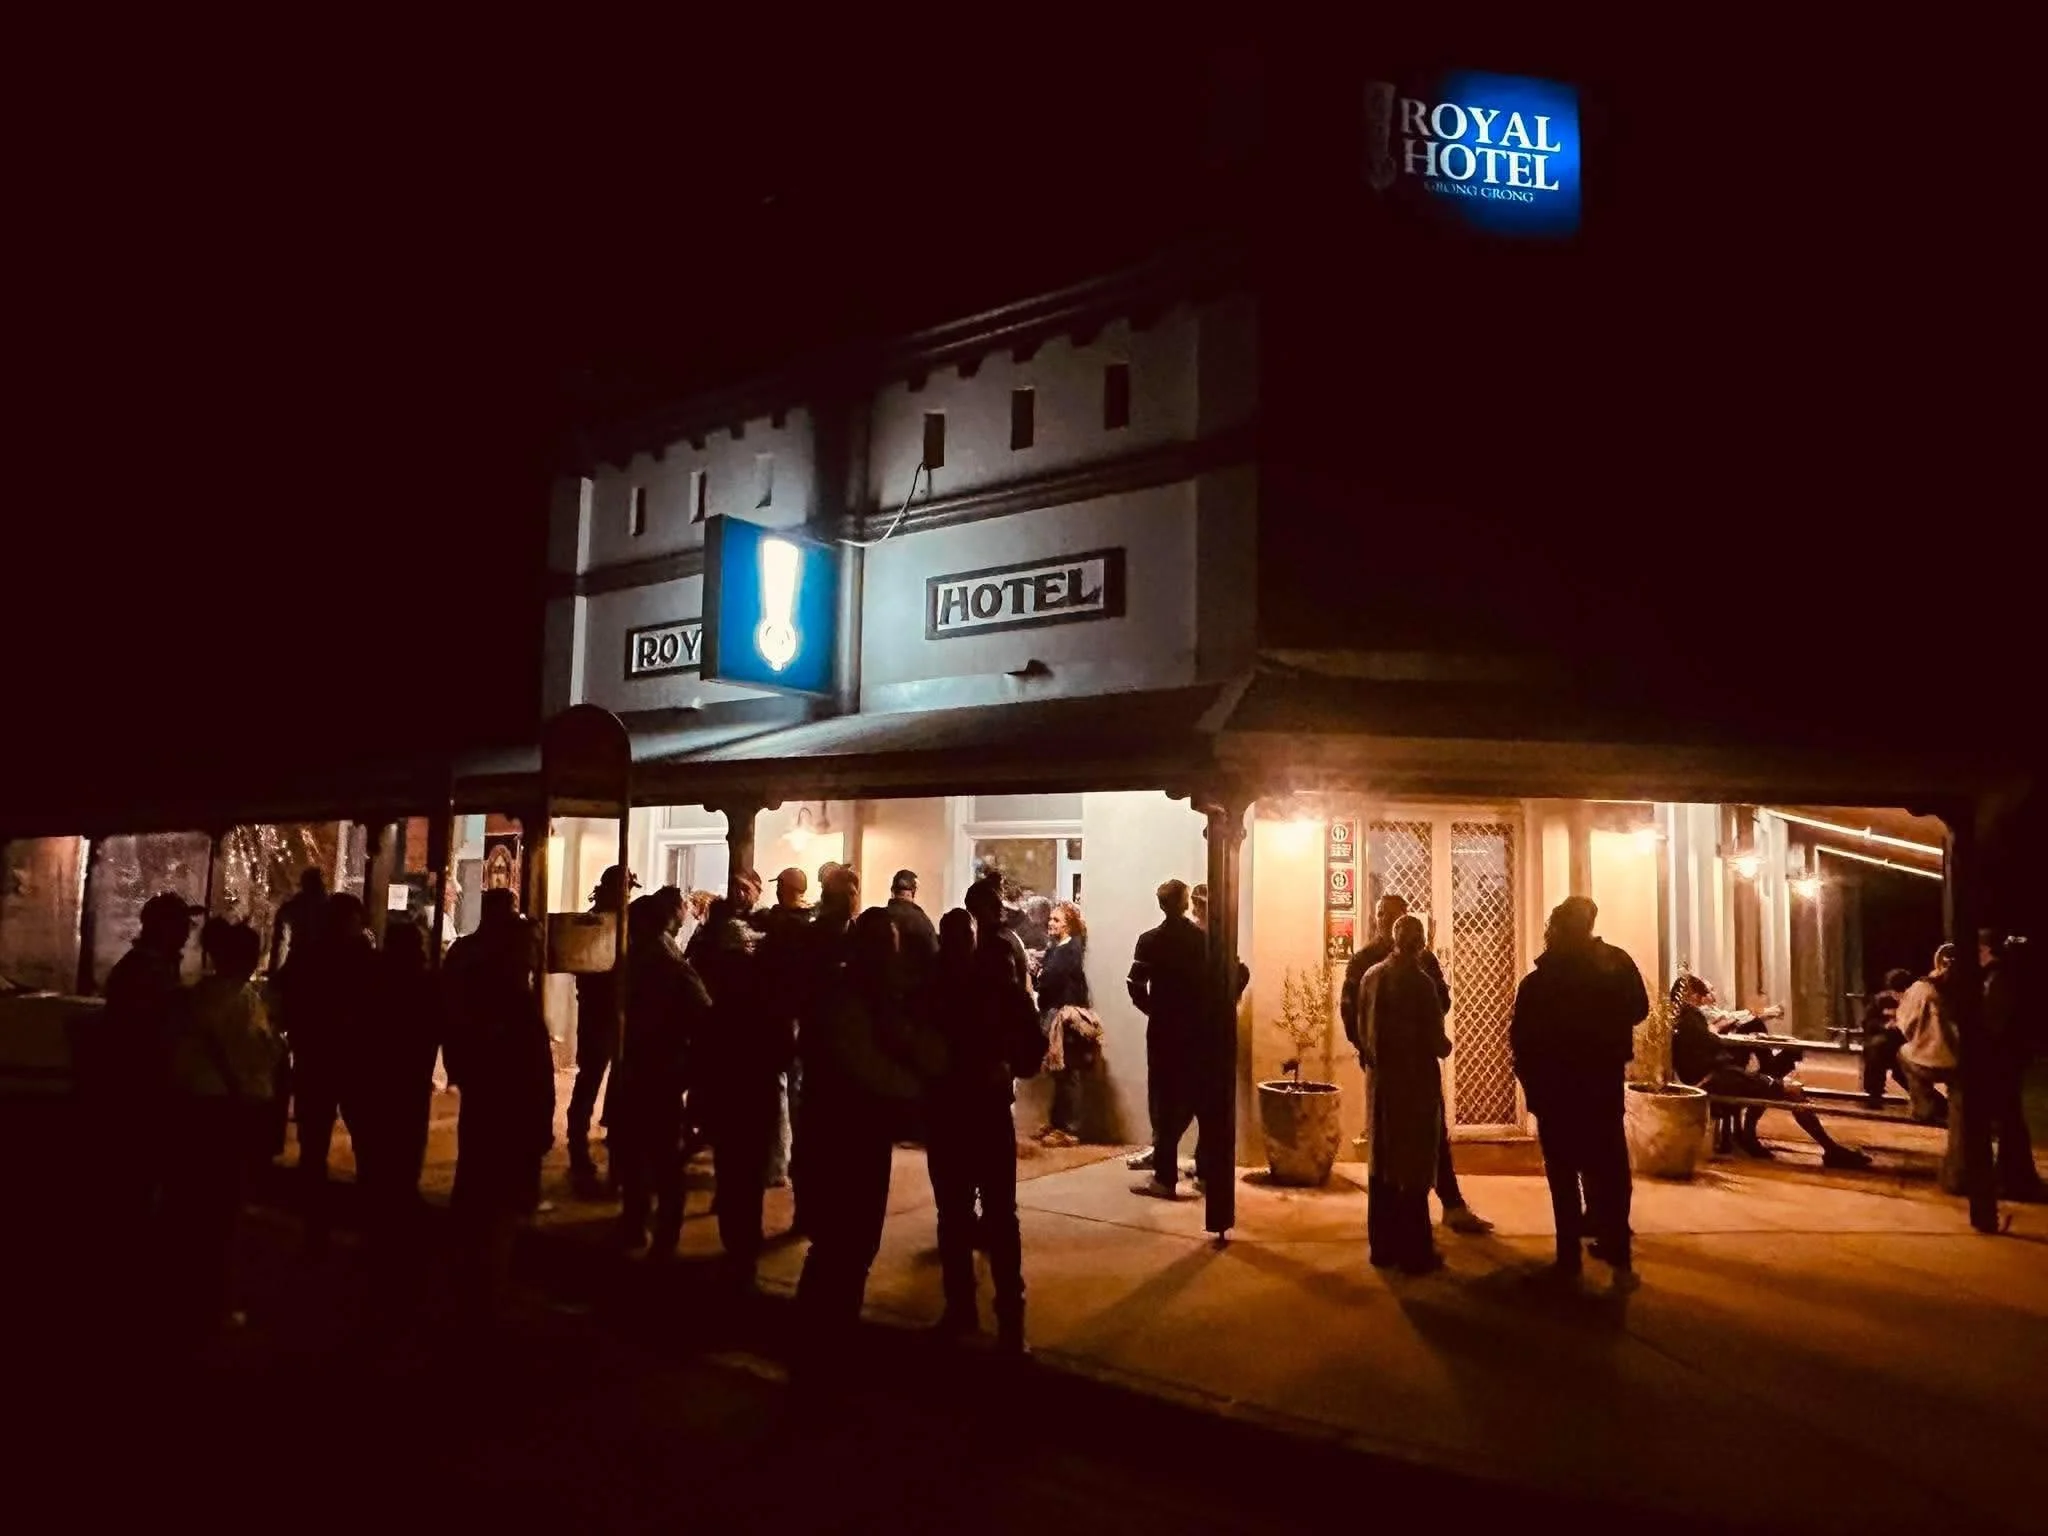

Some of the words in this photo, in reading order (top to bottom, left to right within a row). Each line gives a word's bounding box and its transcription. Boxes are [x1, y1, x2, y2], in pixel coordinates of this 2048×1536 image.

[1400, 97, 1561, 152] ROYAL
[1403, 138, 1559, 191] HOTEL
[939, 567, 1102, 625] HOTEL
